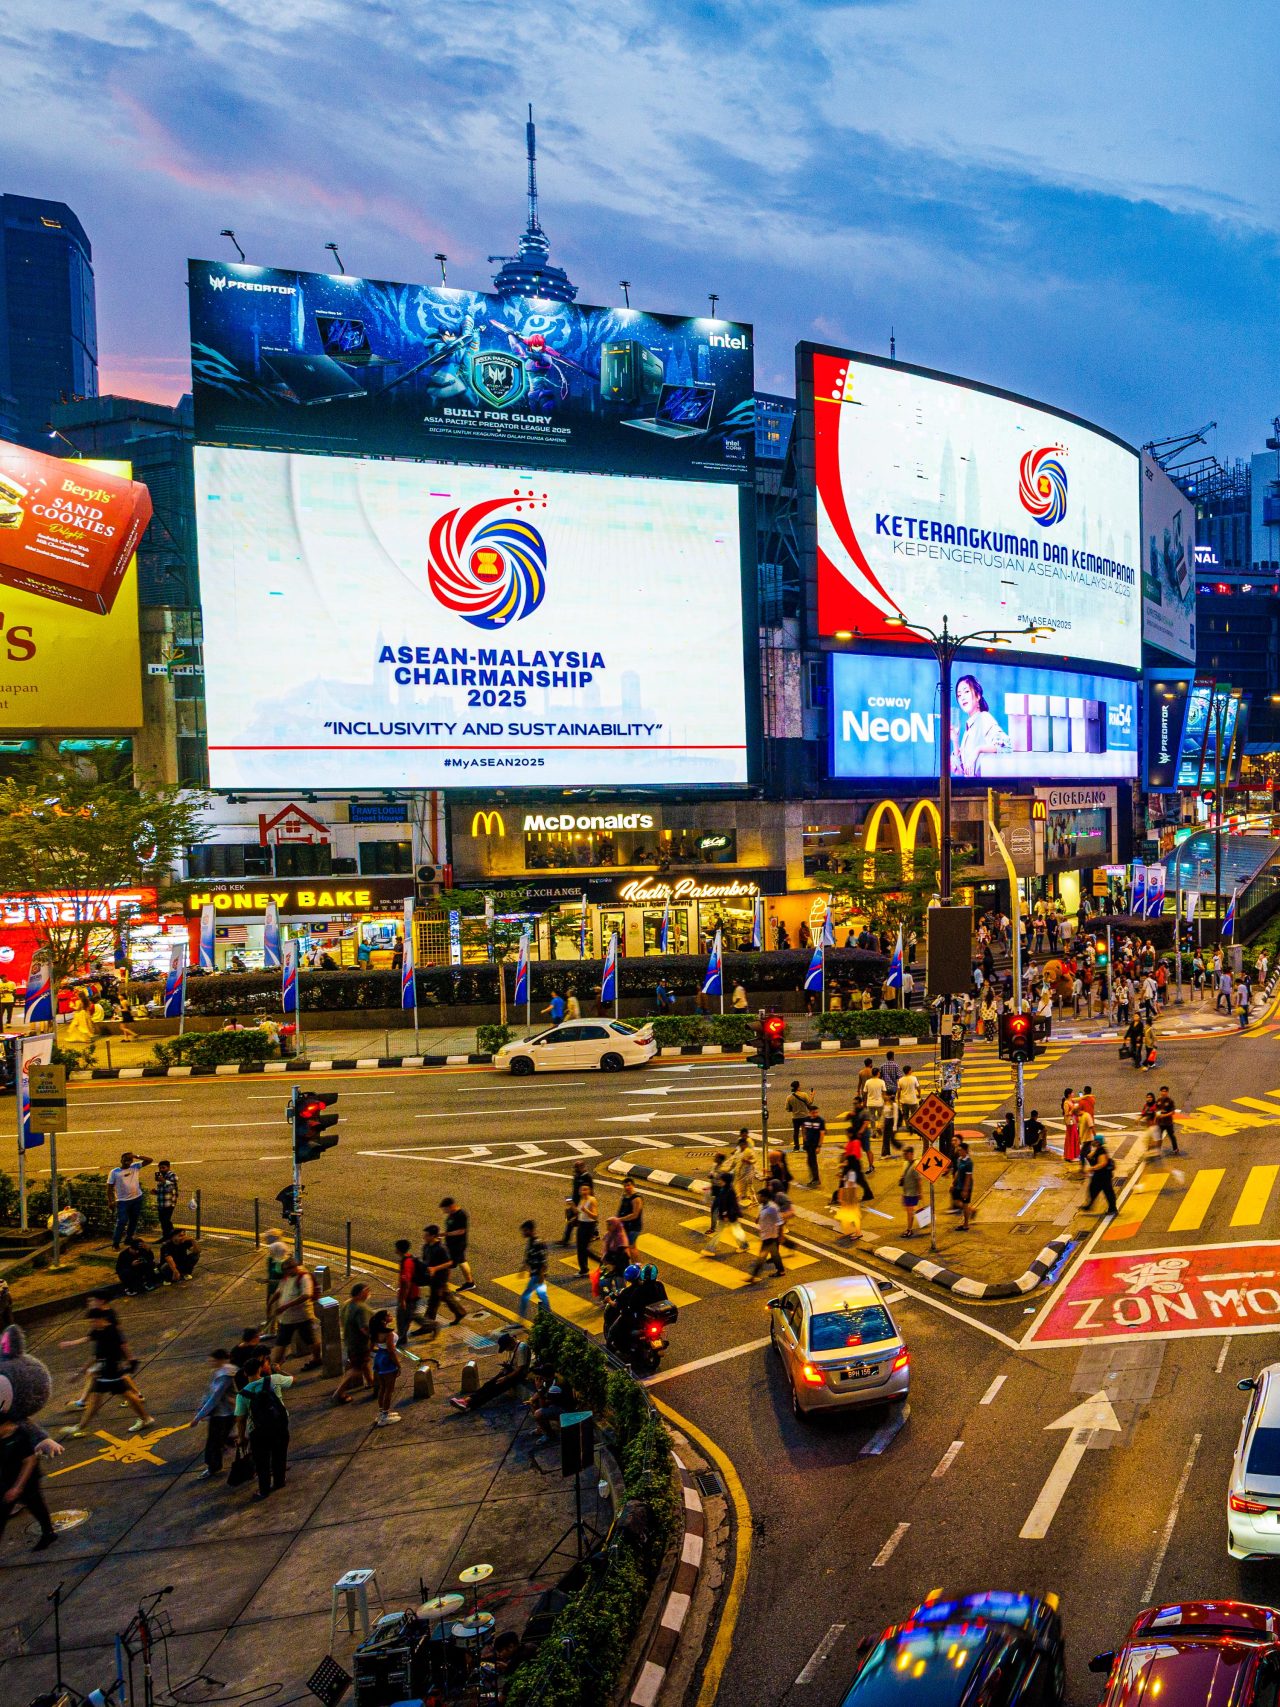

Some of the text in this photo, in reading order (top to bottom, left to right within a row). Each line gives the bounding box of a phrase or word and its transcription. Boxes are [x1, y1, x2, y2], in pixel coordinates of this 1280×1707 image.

[227, 281, 297, 297] PREDATOR
[423, 416, 444, 424] ASIA
[445, 417, 478, 427] PACIFIC
[479, 420, 520, 430] PREDATOR
[520, 424, 551, 433] LEAGUE
[443, 407, 552, 425] BUILT FOR GLORY
[61, 479, 112, 503] Beryl's
[52, 497, 103, 520] SAND
[32, 504, 116, 537] COOKIES
[875, 513, 1135, 586] KETERANGKUMAN DAN KEMAMPANAN
[893, 540, 1132, 598] KEPENGERUSIAN ASEAN-MALAYSIA 2025
[1017, 614, 1072, 630] #MyASEAN2025
[378, 645, 606, 669] ASEAN-MALAYSIA
[394, 667, 593, 688] CHAIRMANSHIP
[467, 689, 527, 708] 2025
[867, 696, 911, 710] coway
[462, 722, 503, 736] AND
[1161, 705, 1170, 752] PREDATOR
[443, 757, 545, 769] #MyASEAN2025
[1049, 790, 1107, 807] GIORDANO
[351, 805, 406, 815] TRAVELOGUE
[523, 813, 654, 832] McDonald's
[526, 887, 582, 897] EXCHANGE
[619, 876, 761, 902] Kadir Pasembor
[191, 891, 371, 909] HONEY BAKE
[1068, 1293, 1198, 1331] ZON
